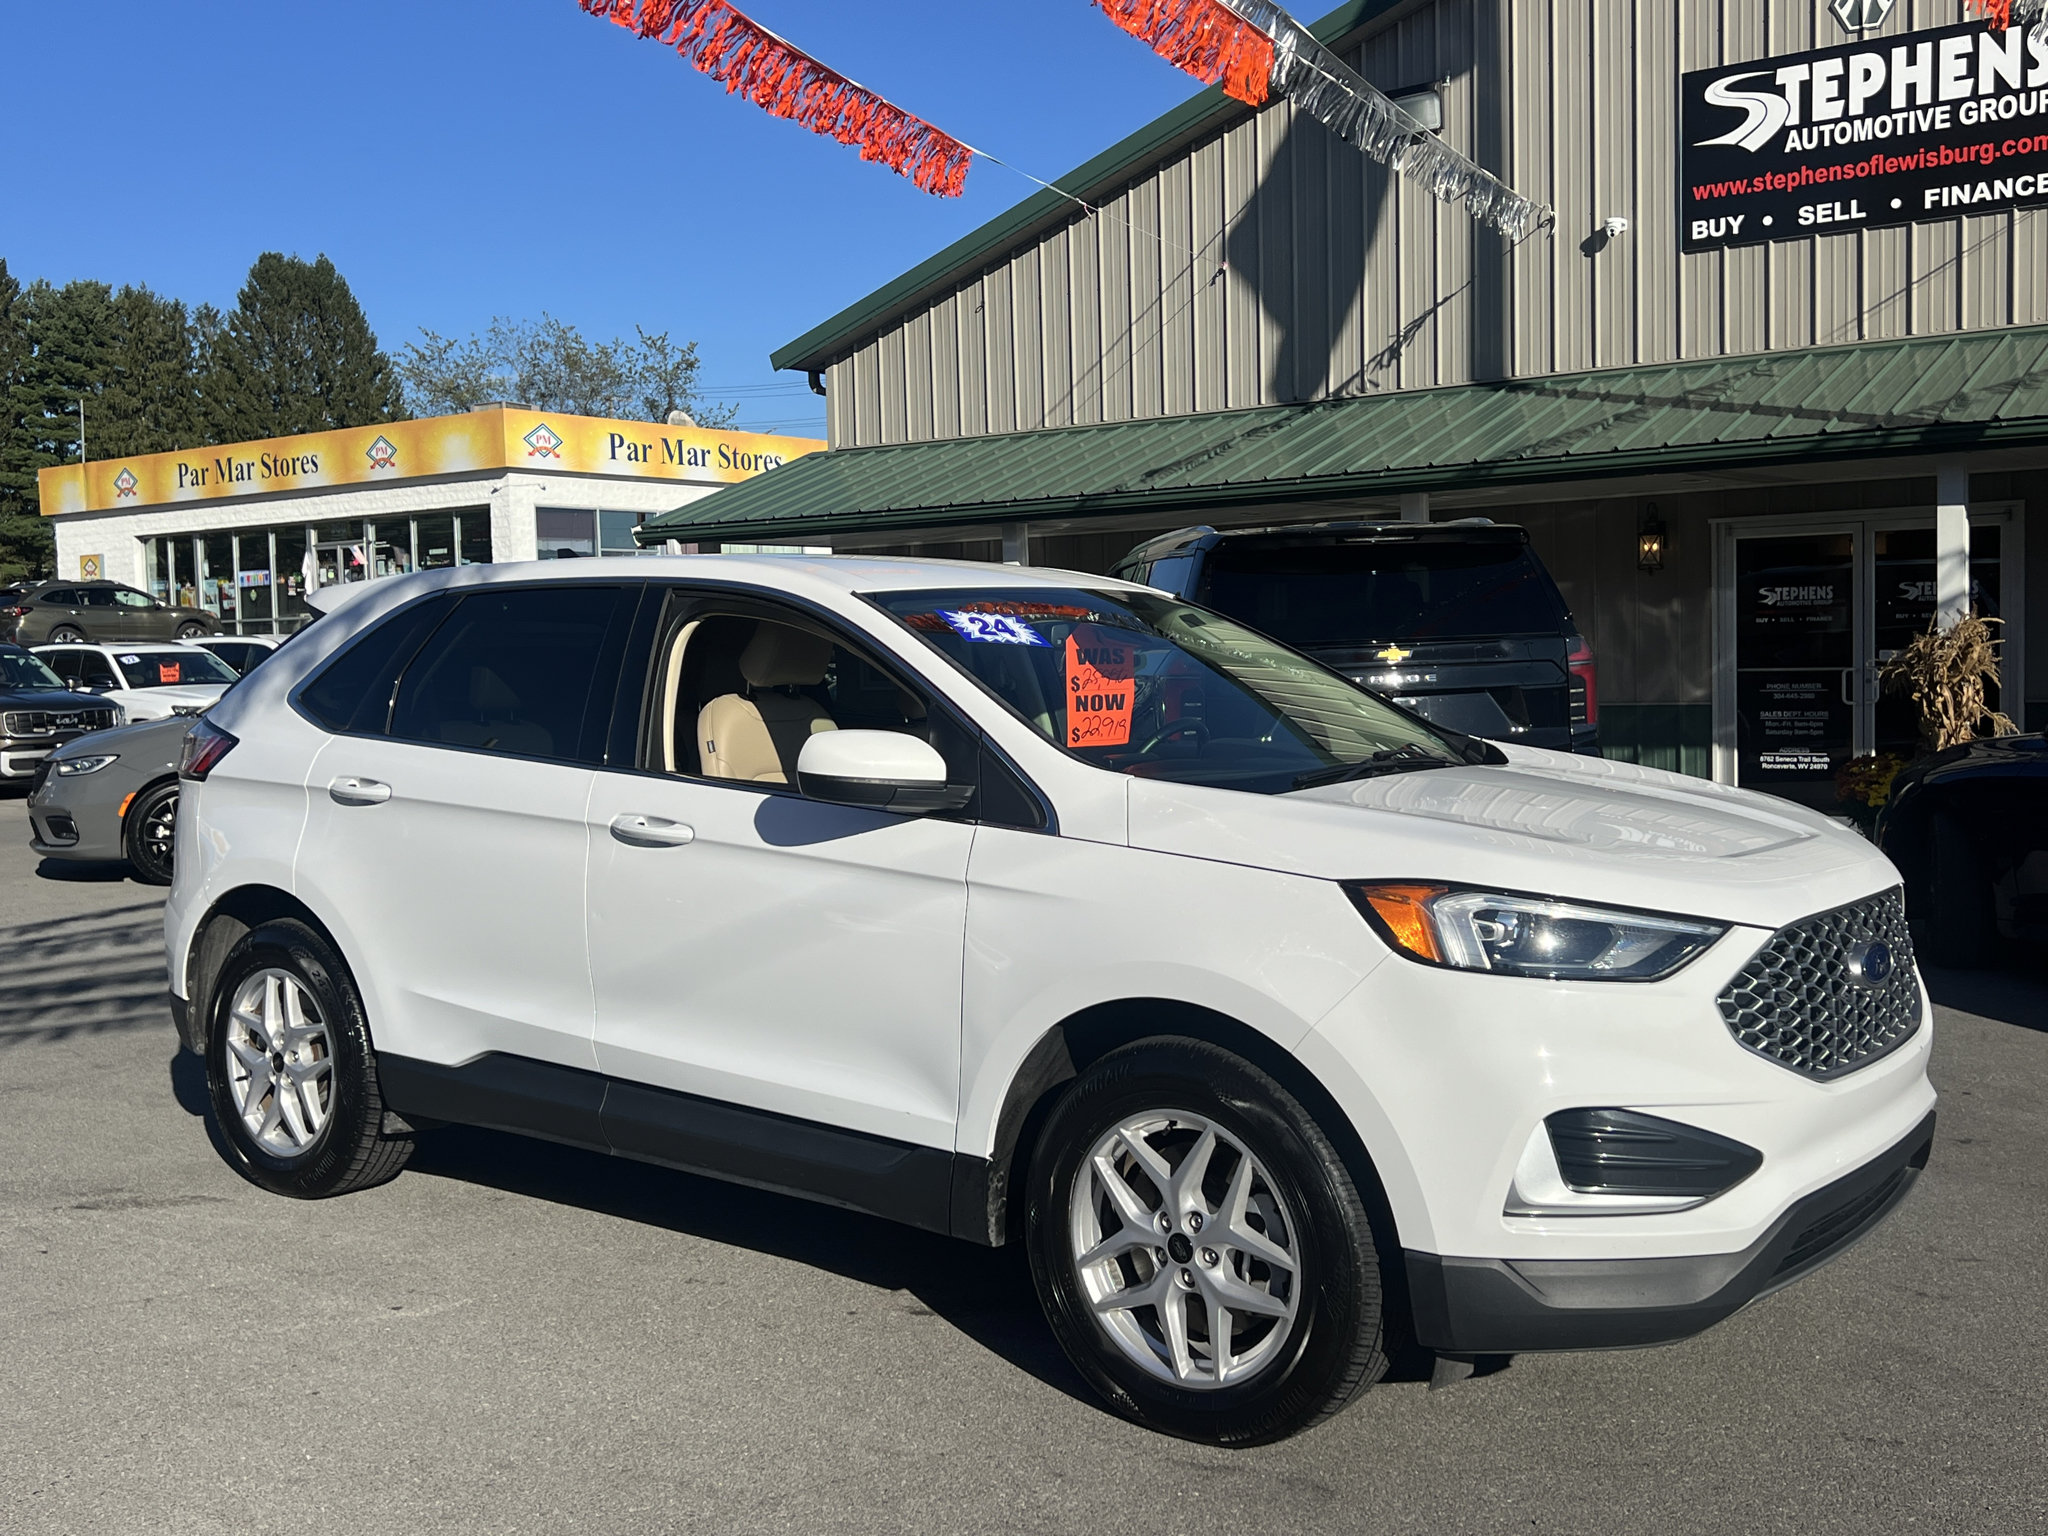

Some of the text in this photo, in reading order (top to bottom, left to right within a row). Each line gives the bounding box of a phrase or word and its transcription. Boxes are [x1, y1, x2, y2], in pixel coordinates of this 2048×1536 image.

[1784, 104, 1952, 153] AUTOMOTIVE
[1692, 134, 2048, 201] www.stephensoflewisburg.com
[1691, 172, 2048, 240] BUY SELL FINANCE
[536, 434, 552, 445] PM
[607, 432, 653, 463] Par
[660, 437, 711, 467] Mar
[375, 446, 389, 457] PM
[177, 452, 319, 488] Par Mar Stores
[1757, 584, 1834, 605] STEPHENS
[968, 616, 1019, 638] 24
[1076, 647, 1126, 666] WAS
[1076, 693, 1126, 712] NOW
